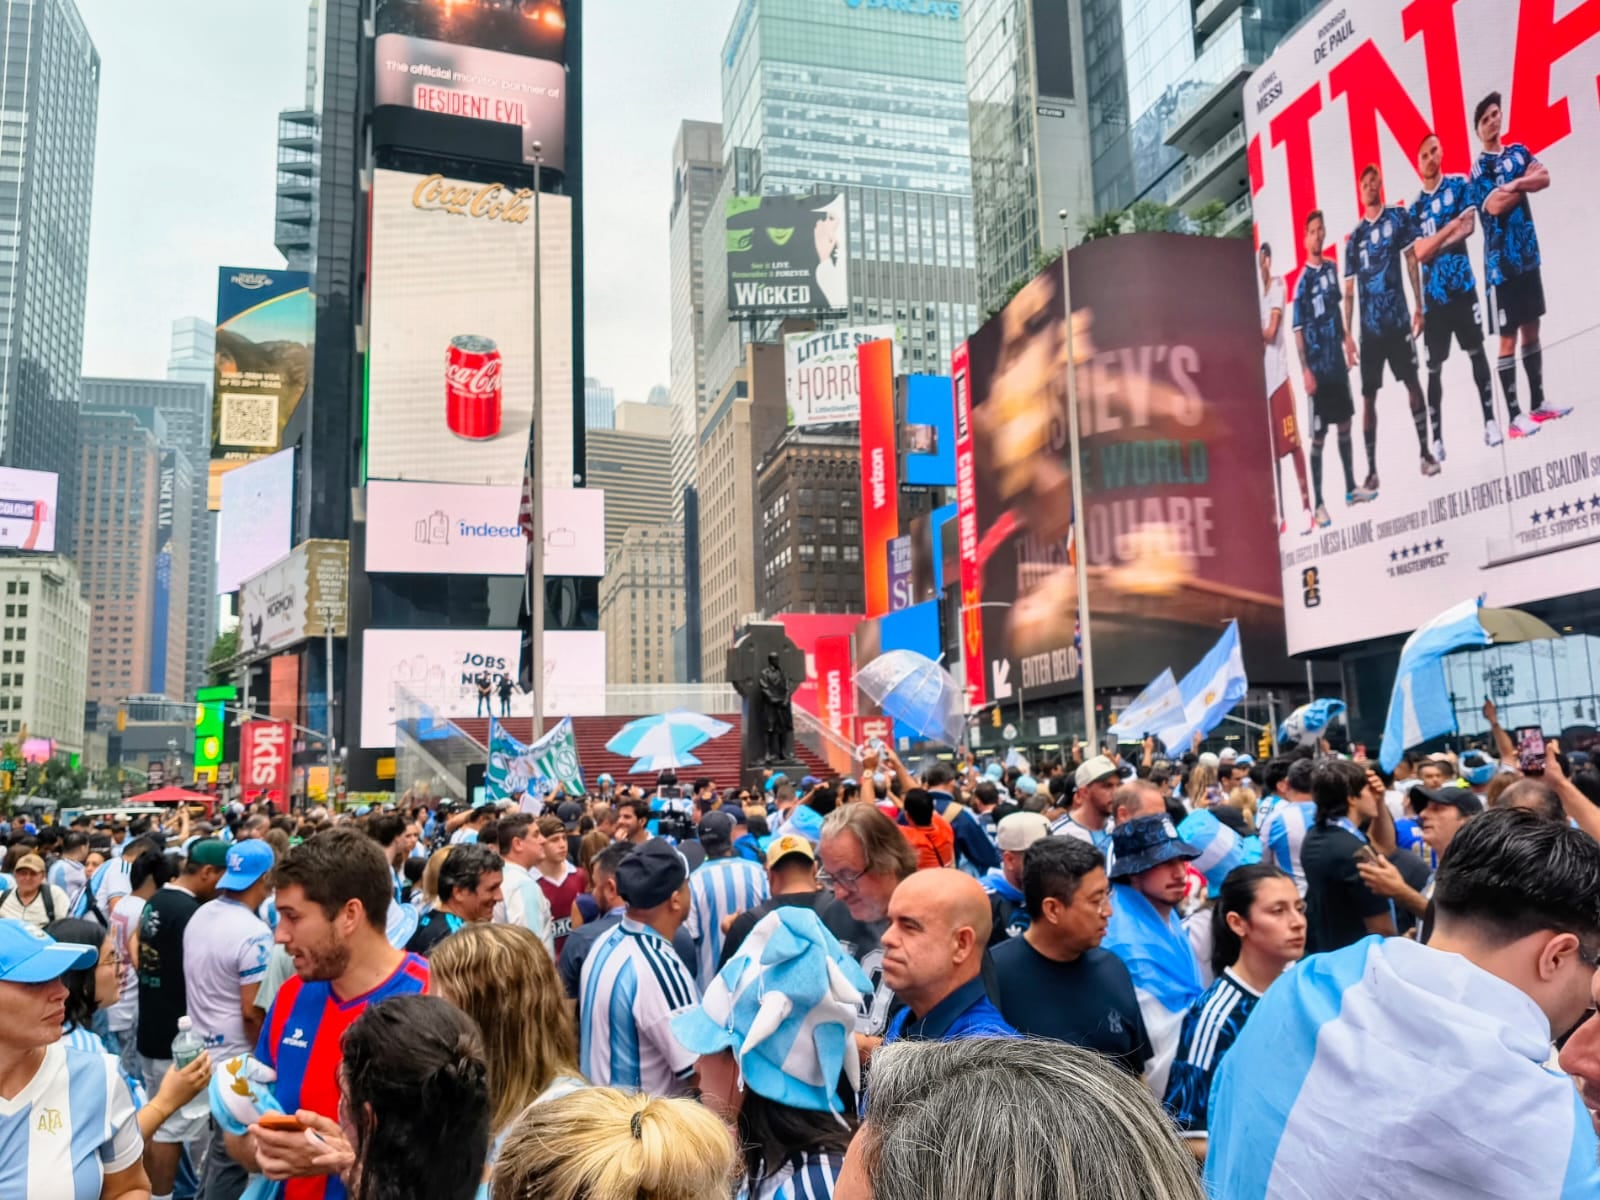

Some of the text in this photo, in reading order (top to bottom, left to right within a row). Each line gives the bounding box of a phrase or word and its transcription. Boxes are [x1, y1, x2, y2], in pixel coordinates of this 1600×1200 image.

[1313, 19, 1355, 65] DE PAUL
[385, 60, 408, 73] The
[409, 63, 452, 81] official
[416, 86, 528, 126] RESIDENT EVIL
[411, 174, 534, 224] Coca-Cola
[797, 331, 849, 364] LITTLE
[872, 446, 885, 509] verizon
[958, 452, 974, 511] COME
[1428, 497, 1447, 525] LUIS
[1449, 492, 1458, 519] DE
[1458, 488, 1472, 516] LA
[1471, 478, 1504, 512] FUENTE
[1513, 466, 1546, 500] LIONEL
[1545, 451, 1589, 490] SCALONI
[459, 521, 521, 538] indeed
[1550, 514, 1589, 537] STRIPES
[463, 652, 506, 670] JOBS
[1021, 652, 1052, 689] ENTER
[252, 726, 284, 786] tkts
